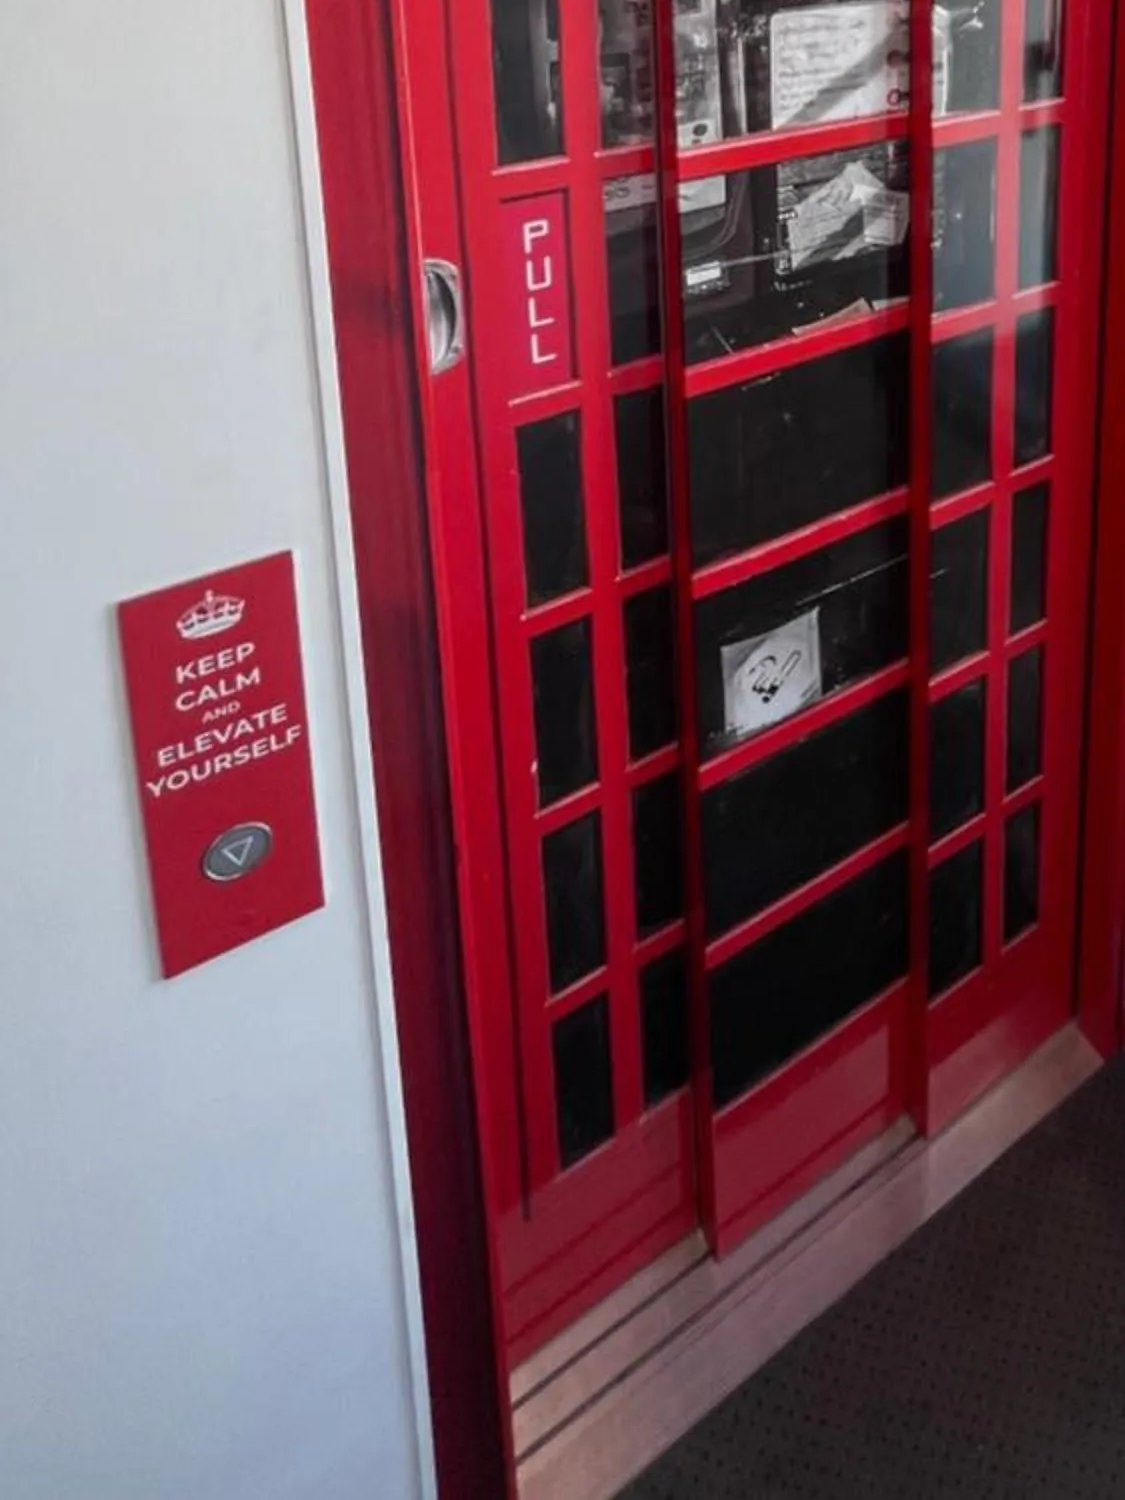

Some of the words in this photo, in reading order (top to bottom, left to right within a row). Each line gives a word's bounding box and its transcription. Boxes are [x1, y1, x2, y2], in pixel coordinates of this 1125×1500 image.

[523, 219, 557, 364] PULL
[175, 642, 256, 684] KEEP
[175, 666, 261, 712] CALM
[157, 703, 287, 768] ELEVATE
[201, 700, 241, 725] AND
[146, 724, 302, 798] YOURSELF
